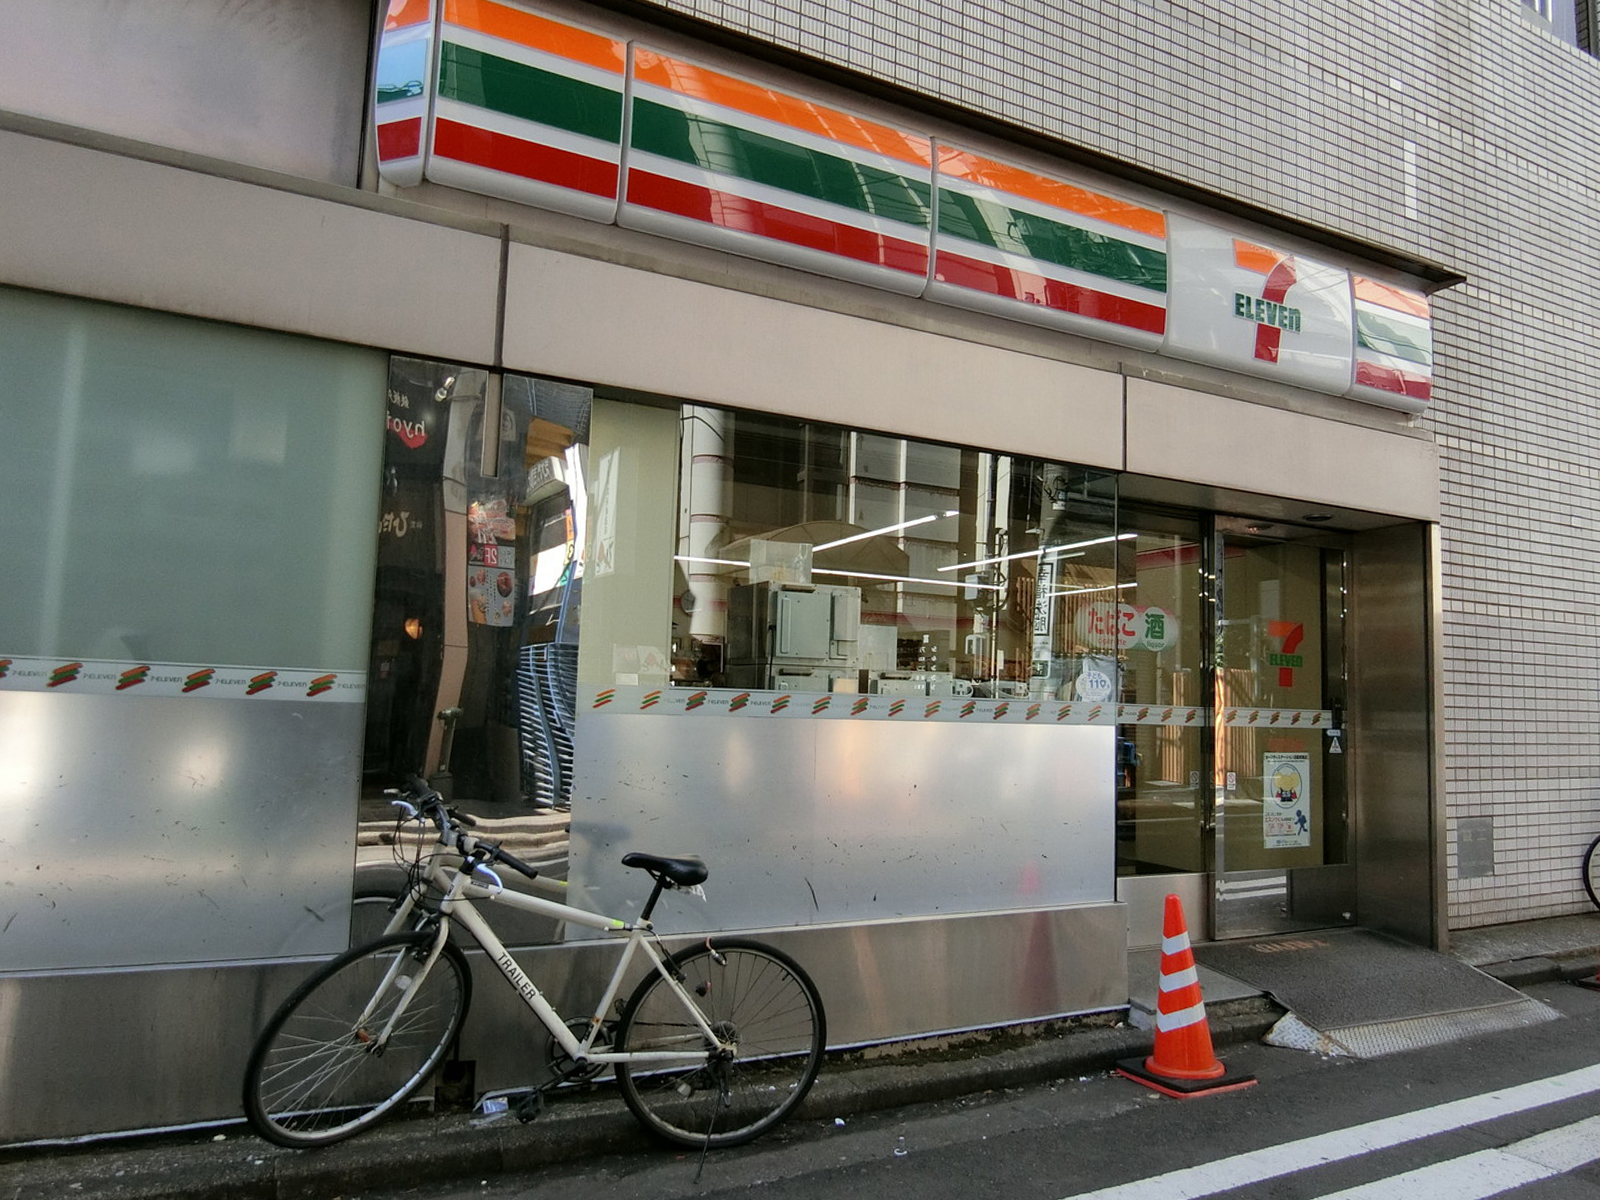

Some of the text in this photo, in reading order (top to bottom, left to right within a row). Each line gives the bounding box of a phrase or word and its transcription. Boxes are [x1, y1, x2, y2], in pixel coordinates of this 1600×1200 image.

[1232, 238, 1297, 364] 7
[1088, 608, 1135, 637] たばこ
[1144, 612, 1164, 639] 酒
[1269, 620, 1304, 688] 7
[498, 951, 536, 1000] TRAILER
